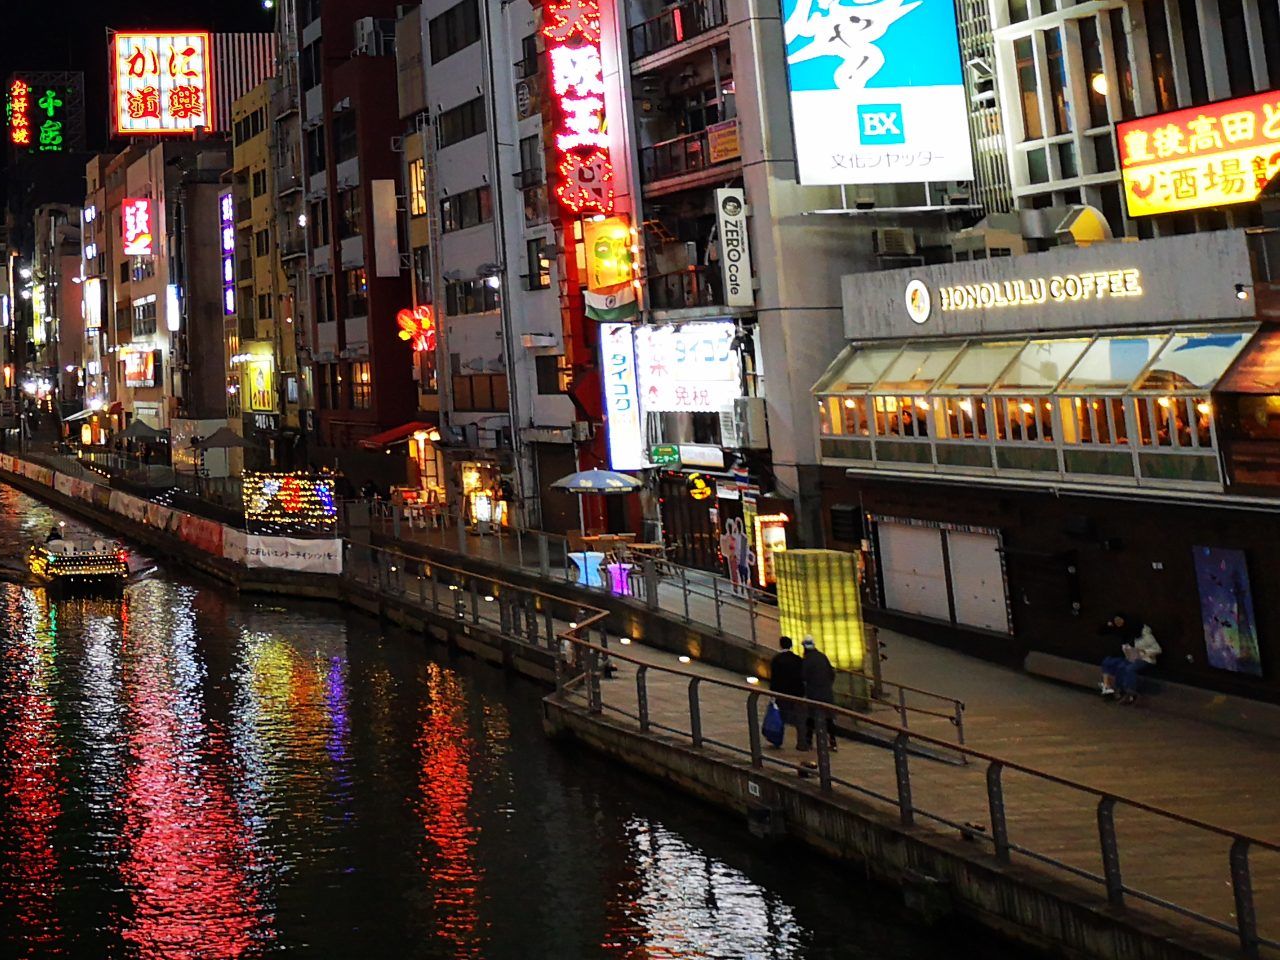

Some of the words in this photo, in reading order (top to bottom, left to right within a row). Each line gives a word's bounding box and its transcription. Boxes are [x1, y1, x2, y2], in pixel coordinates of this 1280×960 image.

[126, 45, 200, 78] かに
[862, 112, 900, 136] BX
[831, 149, 946, 170] 文化シャッター
[1154, 157, 1246, 202] 酒場
[940, 277, 1047, 311] HONOLULU
[1049, 268, 1143, 302] COFFEE
[675, 385, 710, 406] 免税
